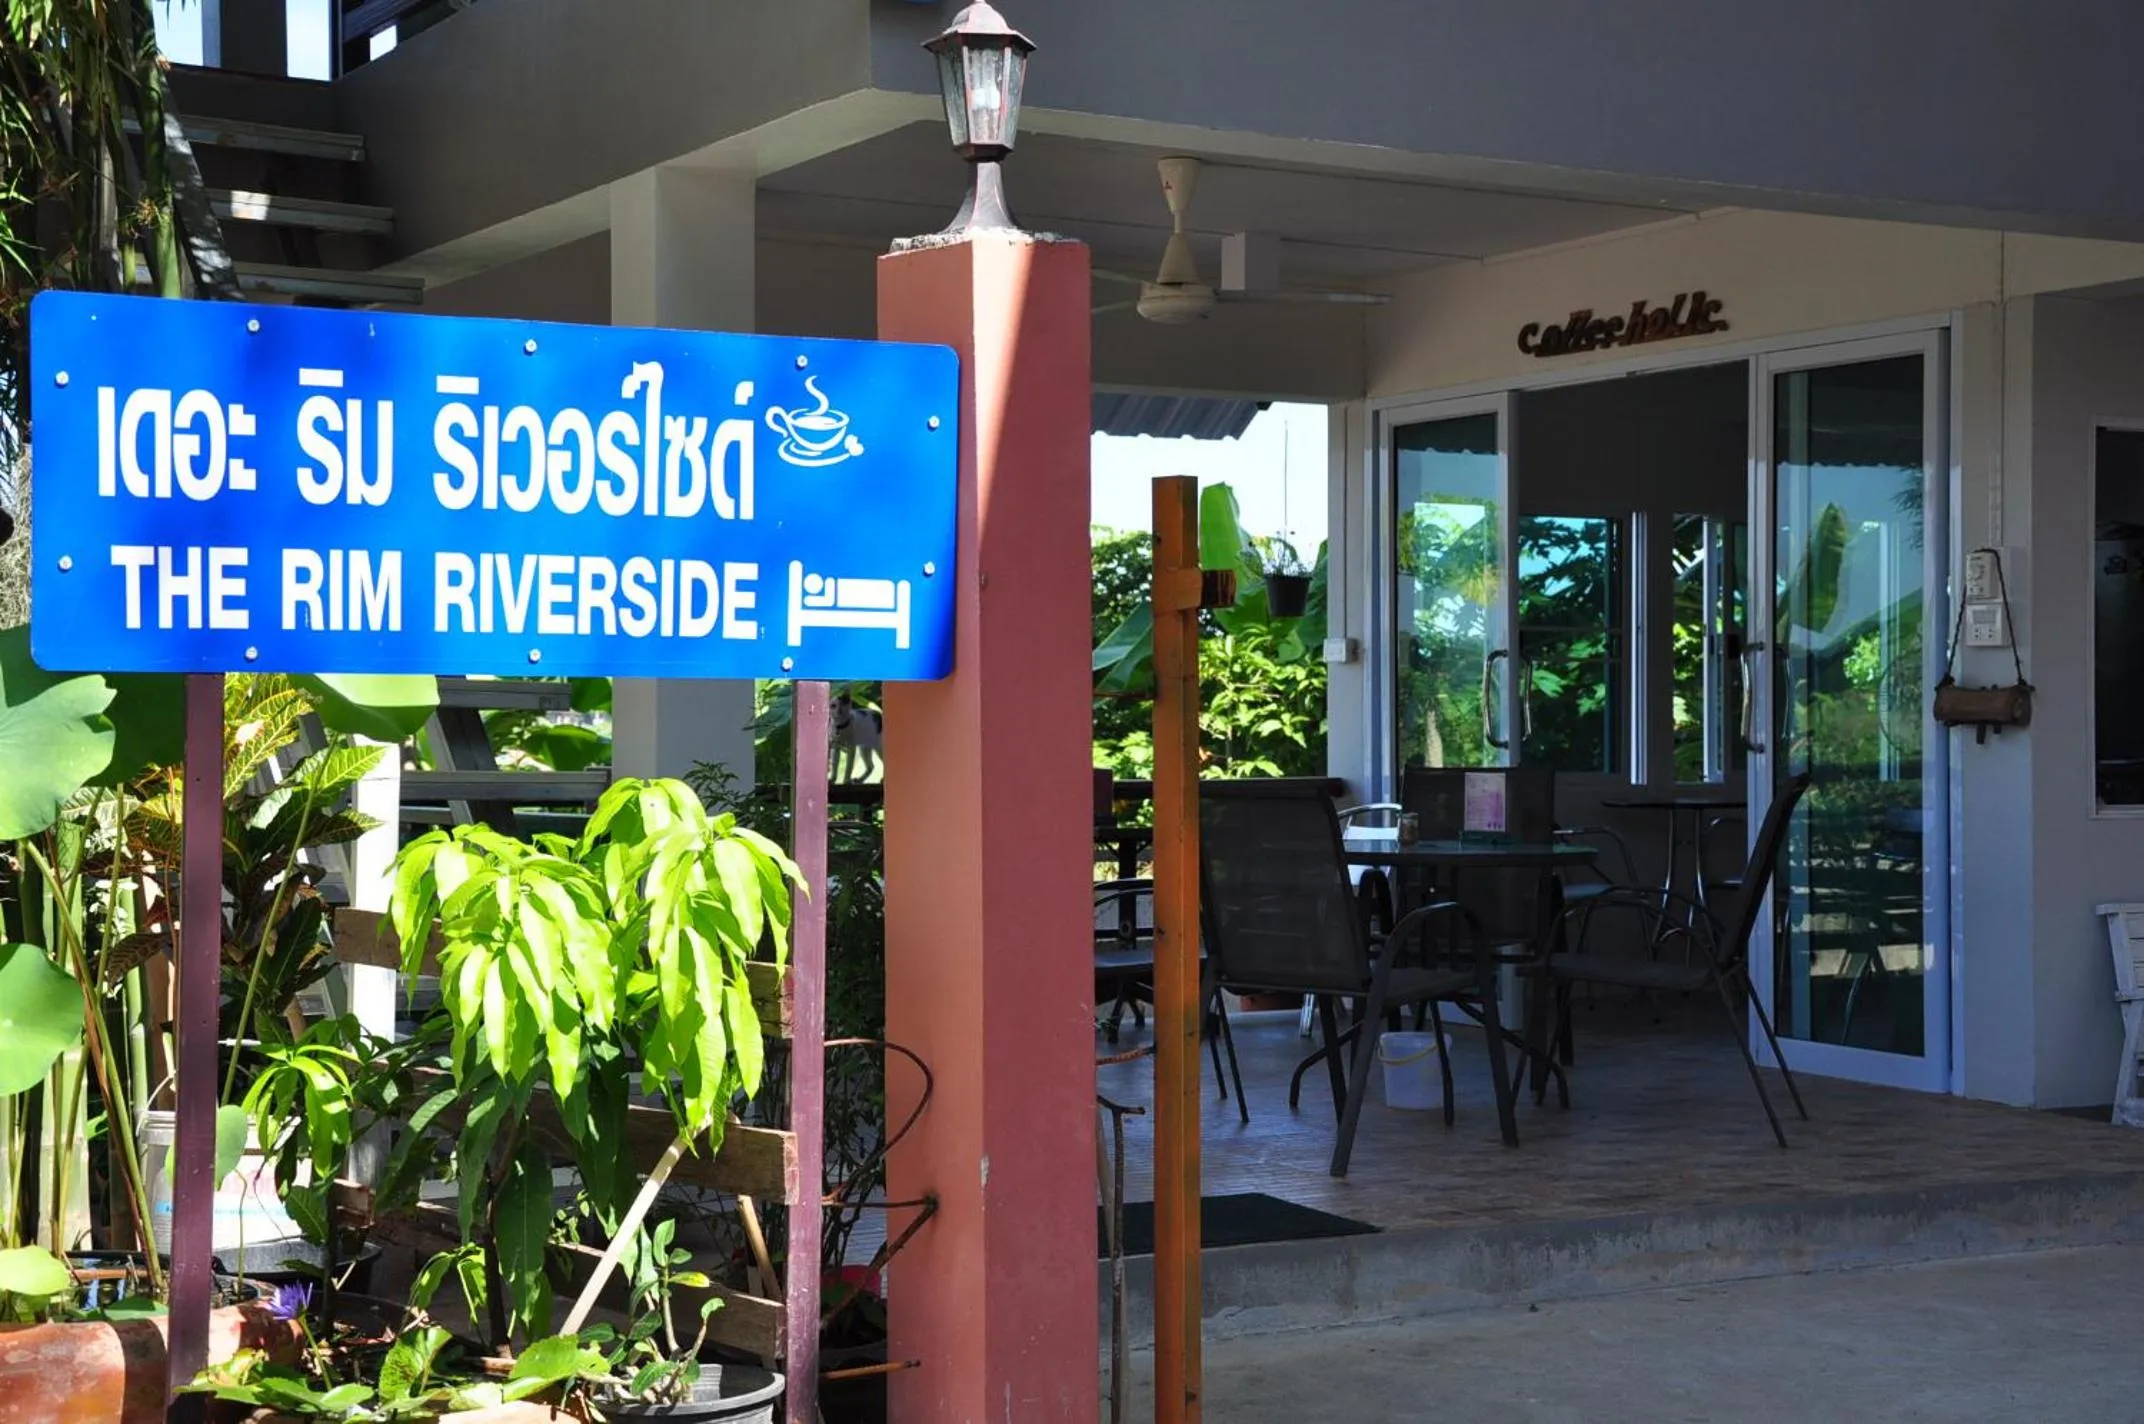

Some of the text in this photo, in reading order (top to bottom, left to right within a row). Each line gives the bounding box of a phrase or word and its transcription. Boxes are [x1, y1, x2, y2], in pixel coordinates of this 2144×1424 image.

[97, 360, 755, 521] เดอะ ริม ริเวอร์ไซด์
[110, 544, 760, 641] THE RIM RIVERSIDE
